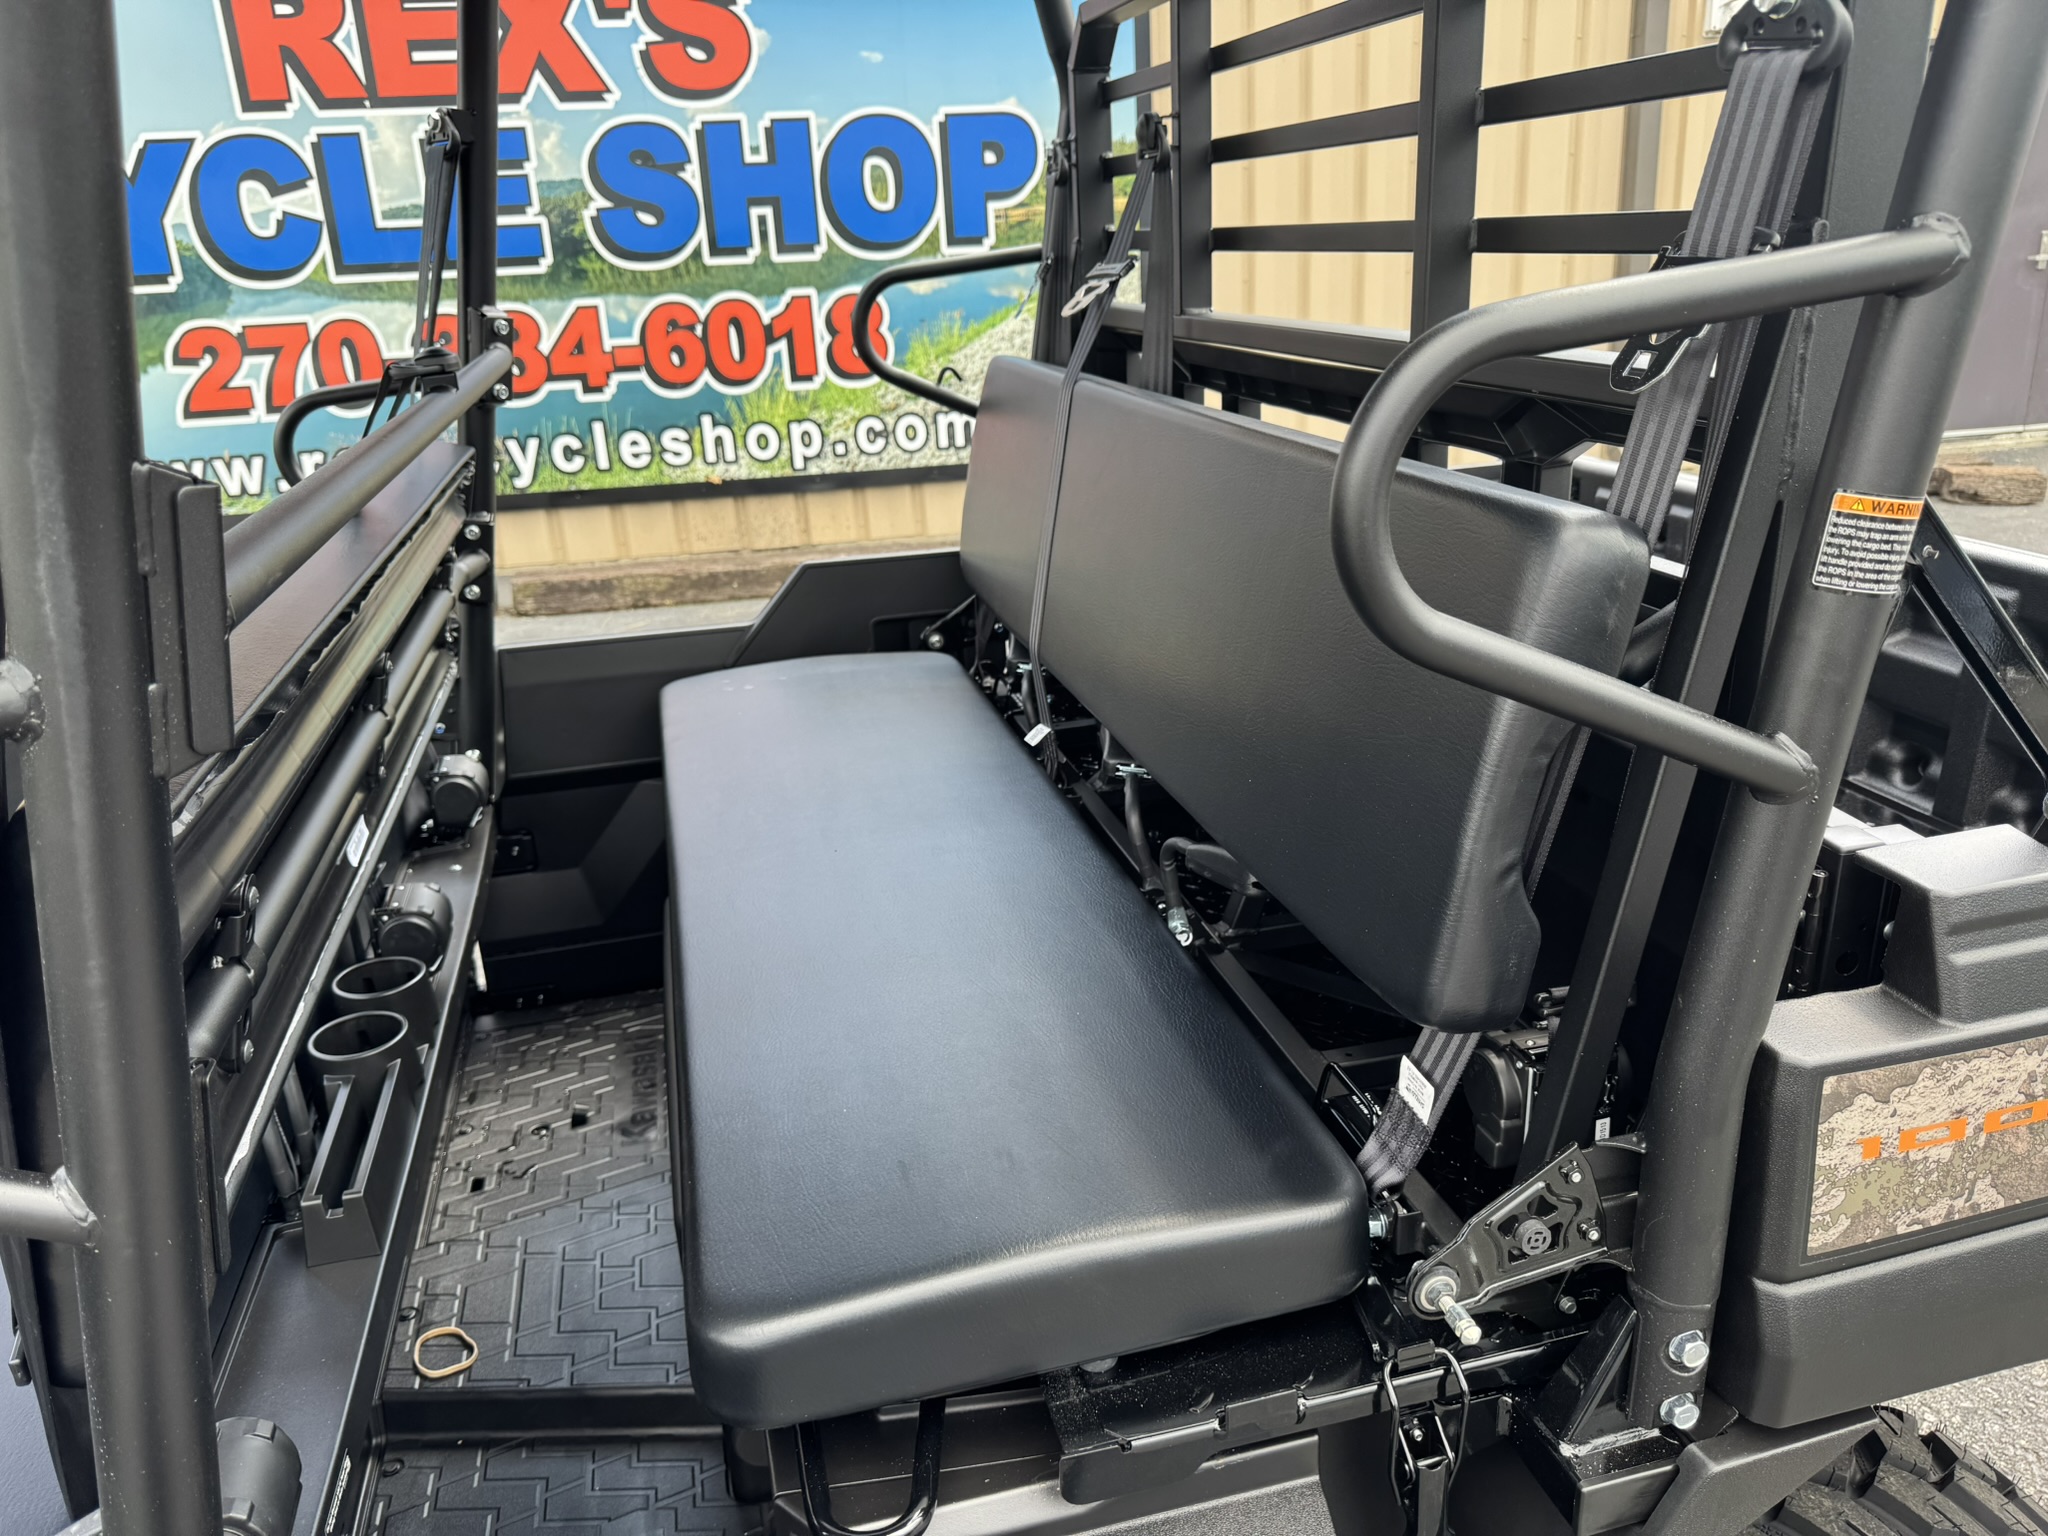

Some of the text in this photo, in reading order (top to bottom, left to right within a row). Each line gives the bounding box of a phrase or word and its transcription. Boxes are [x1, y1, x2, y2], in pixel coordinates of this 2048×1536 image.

[232, 0, 754, 105] REXS
[125, 110, 1040, 281] YCLE SHOP
[174, 293, 889, 419] 27084-6018
[1862, 541, 1880, 551] cargo
[1847, 560, 1874, 569] provided
[1828, 565, 1847, 576] ROPS
[1855, 581, 1879, 591] lowering
